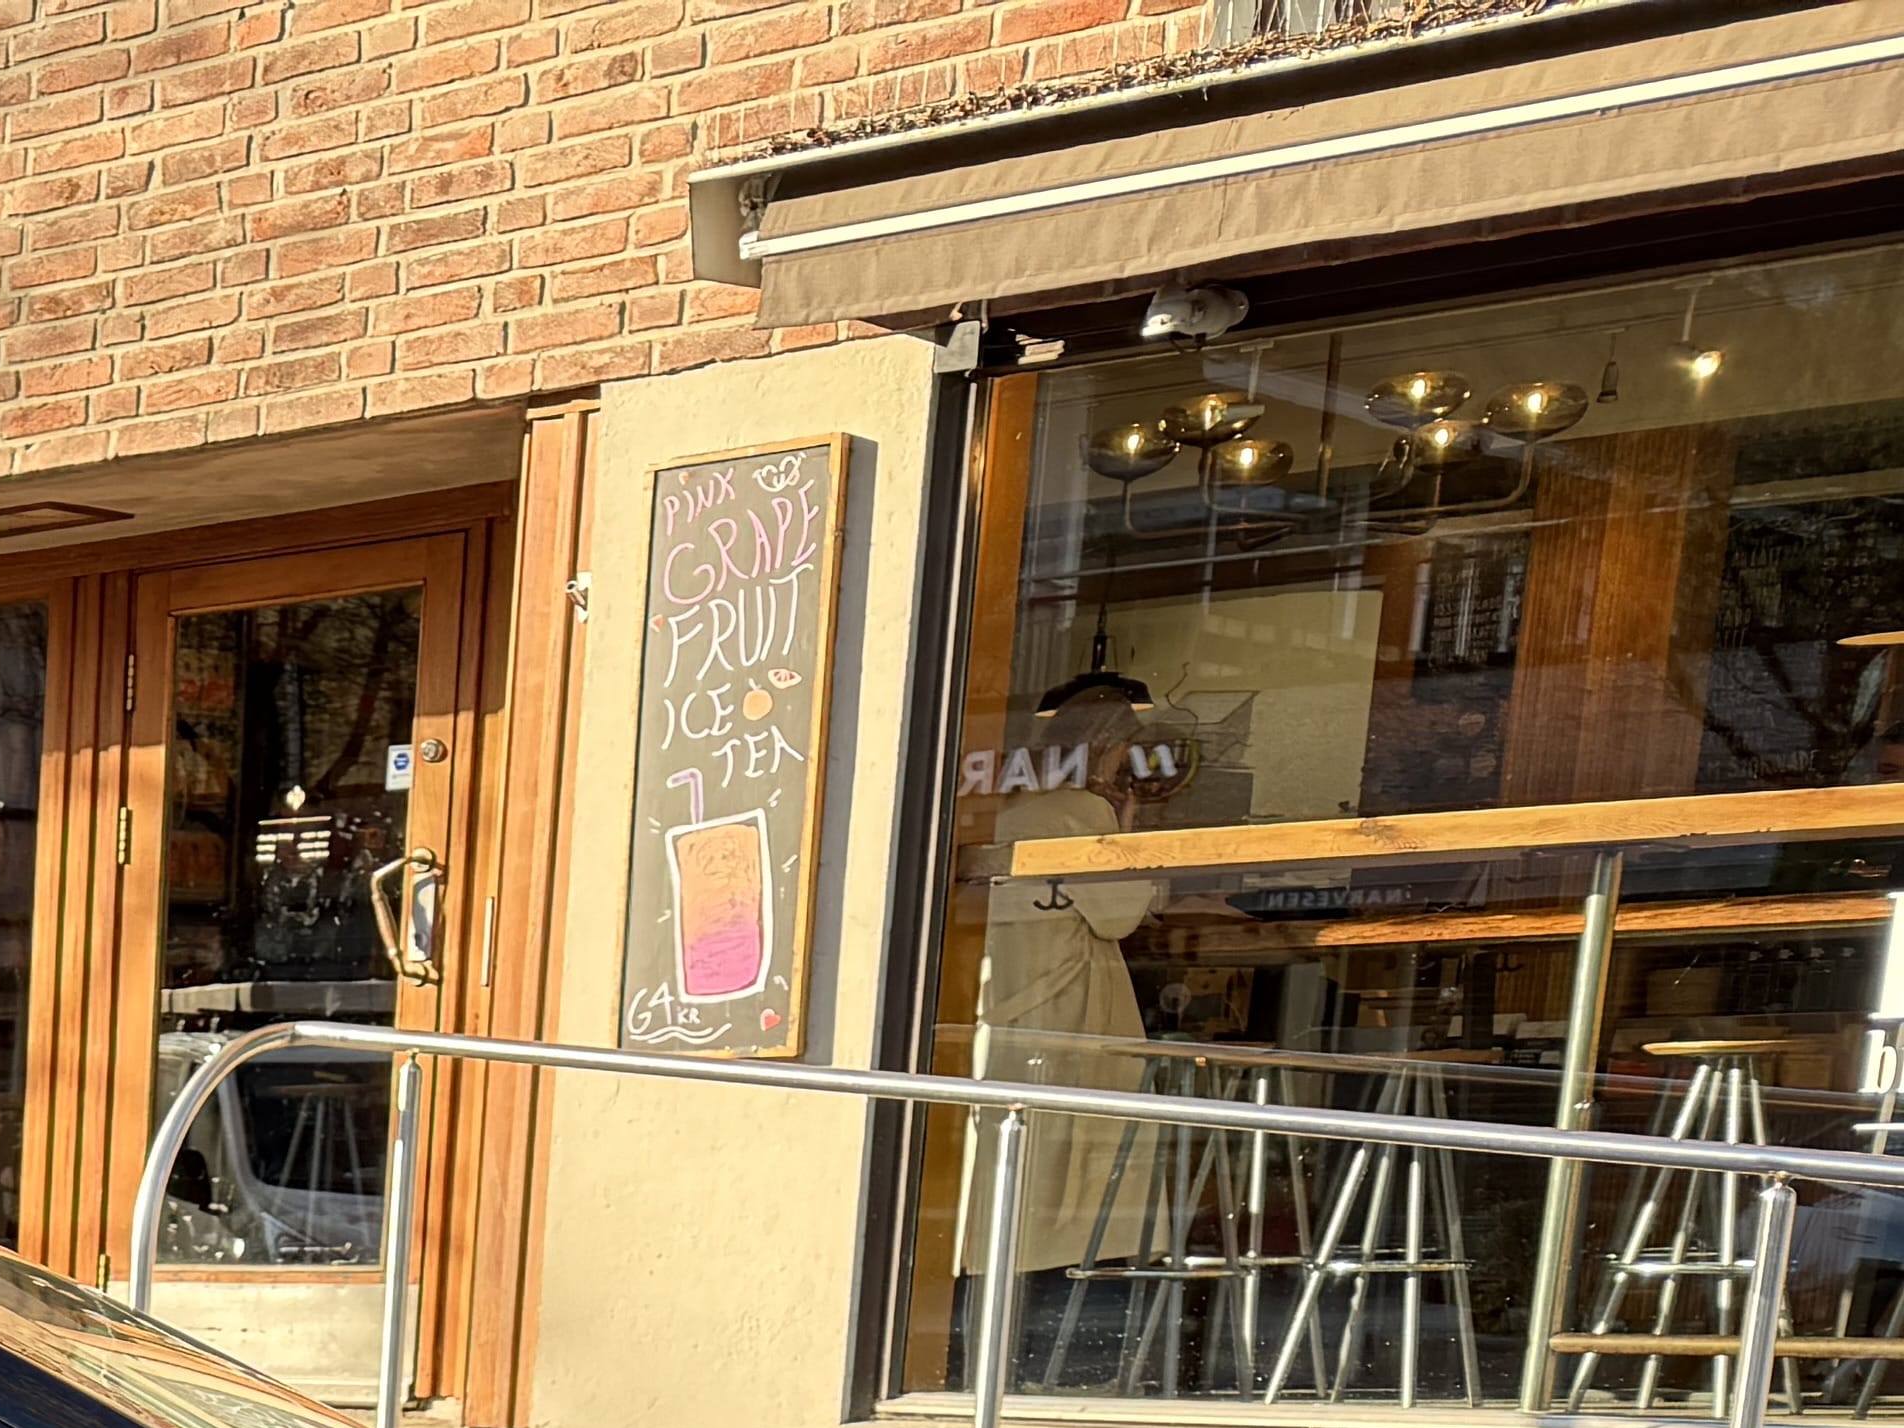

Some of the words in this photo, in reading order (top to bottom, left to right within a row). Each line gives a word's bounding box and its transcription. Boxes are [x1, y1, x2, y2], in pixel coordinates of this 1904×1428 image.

[663, 479, 820, 606] GRAPE
[663, 564, 814, 689] FRUIT
[661, 682, 735, 750] ICE
[712, 725, 806, 789] TEA
